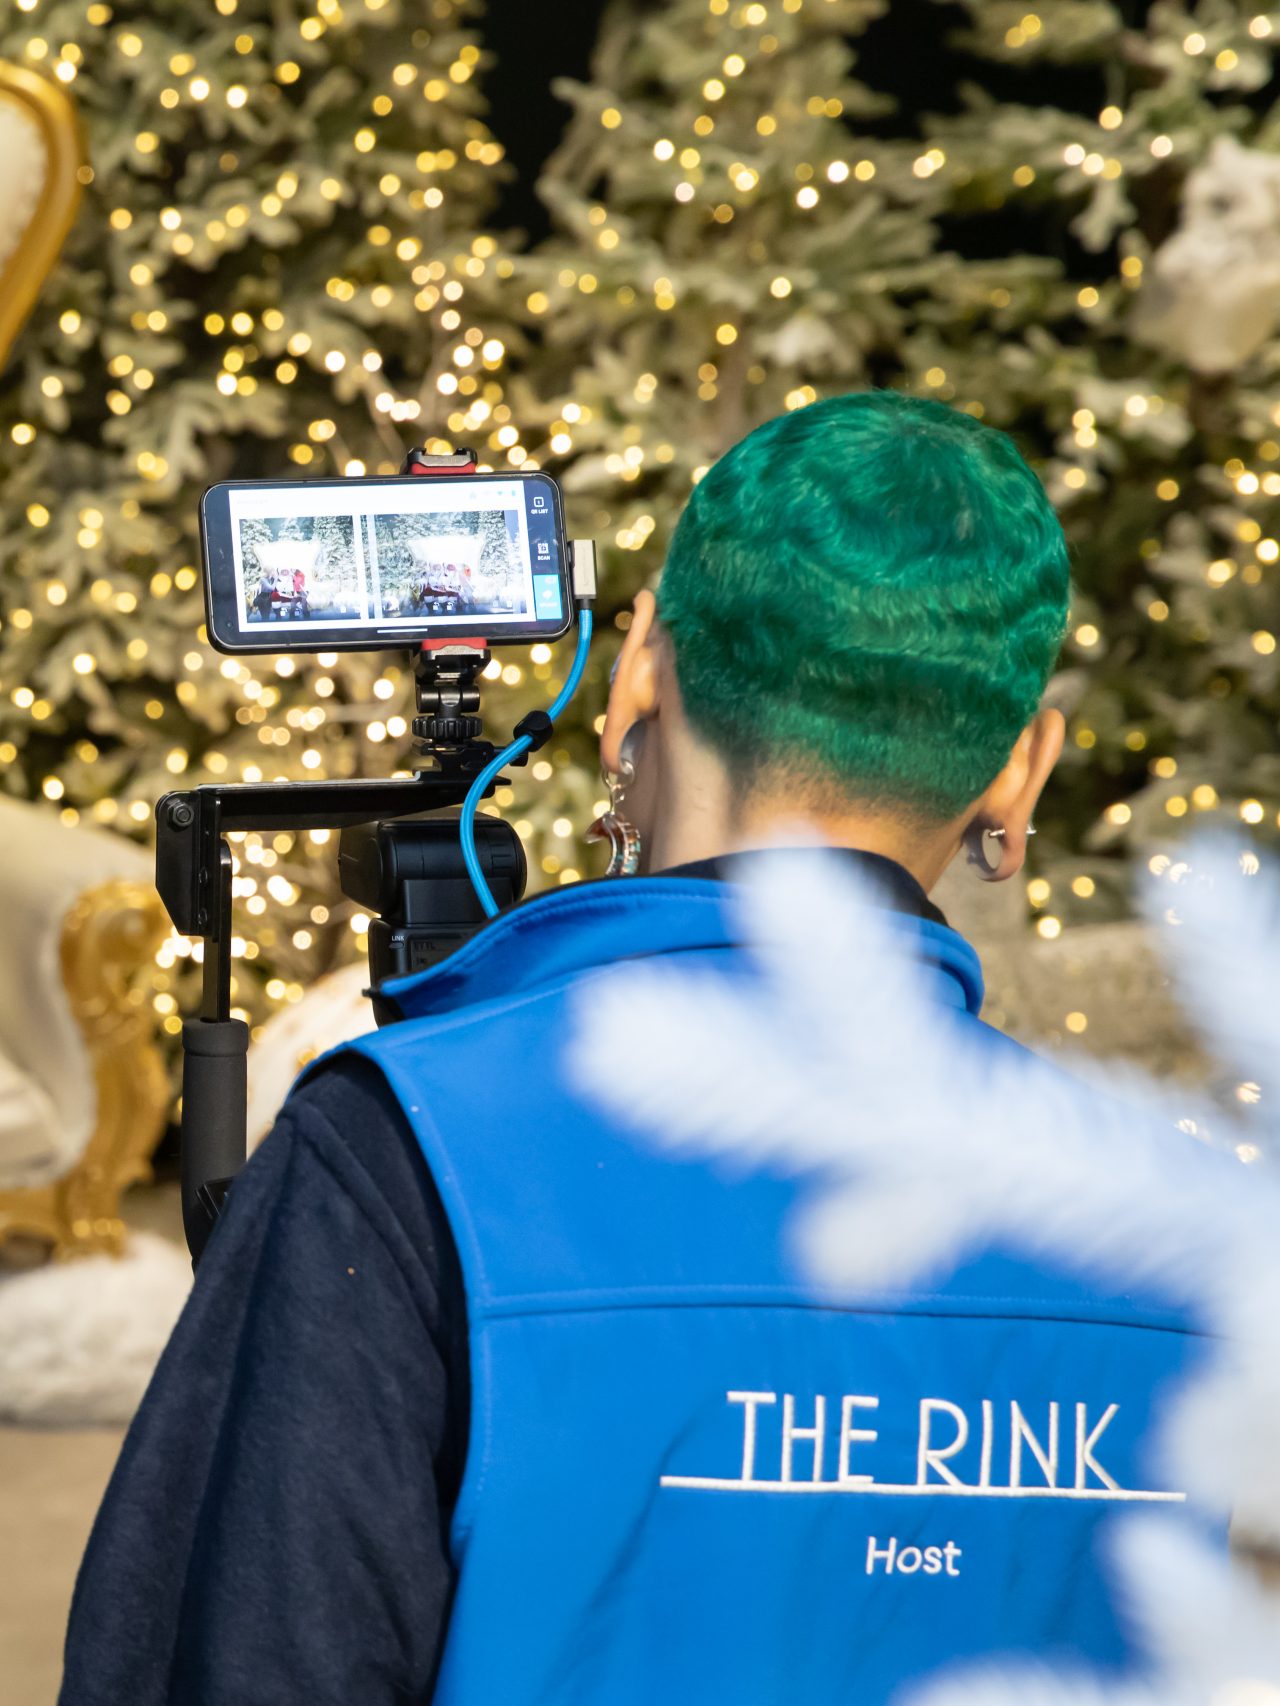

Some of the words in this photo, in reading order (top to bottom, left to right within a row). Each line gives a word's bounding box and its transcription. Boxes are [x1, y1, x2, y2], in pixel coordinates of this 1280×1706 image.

[727, 1390, 879, 1484] THE
[918, 1397, 1120, 1491] RINK
[865, 1536, 962, 1577] Host
